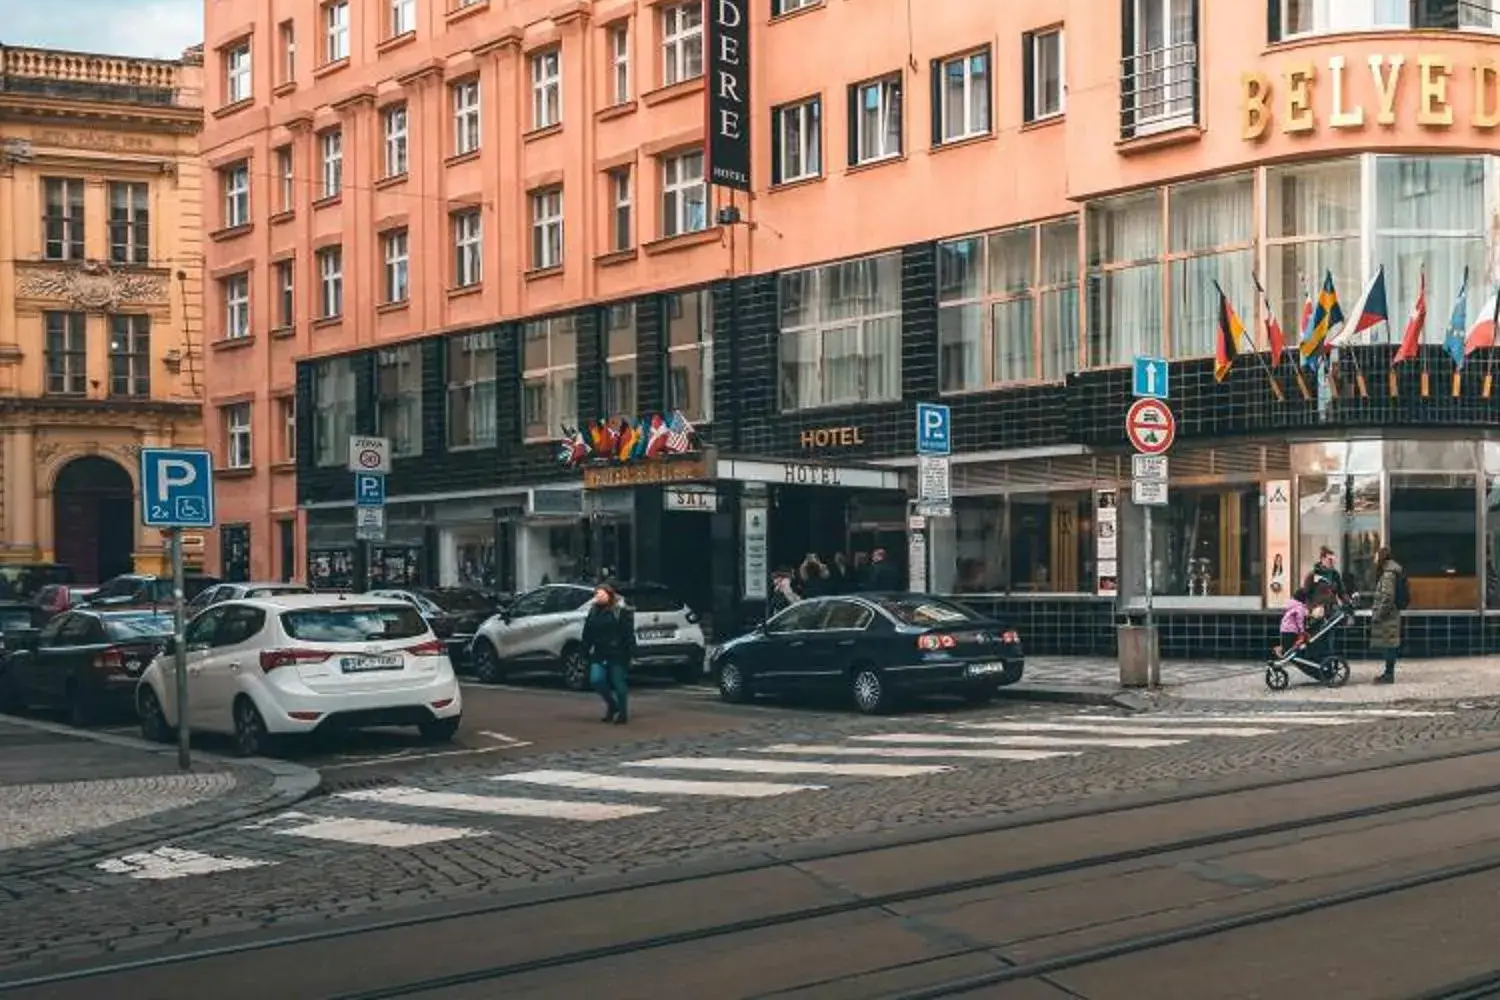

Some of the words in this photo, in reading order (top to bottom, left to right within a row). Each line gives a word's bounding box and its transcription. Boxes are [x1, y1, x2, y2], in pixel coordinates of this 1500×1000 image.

[925, 410, 943, 438] P
[801, 426, 864, 449] HOTEL
[158, 459, 197, 501] P
[784, 464, 841, 485] HOTEL
[361, 477, 377, 497] P
